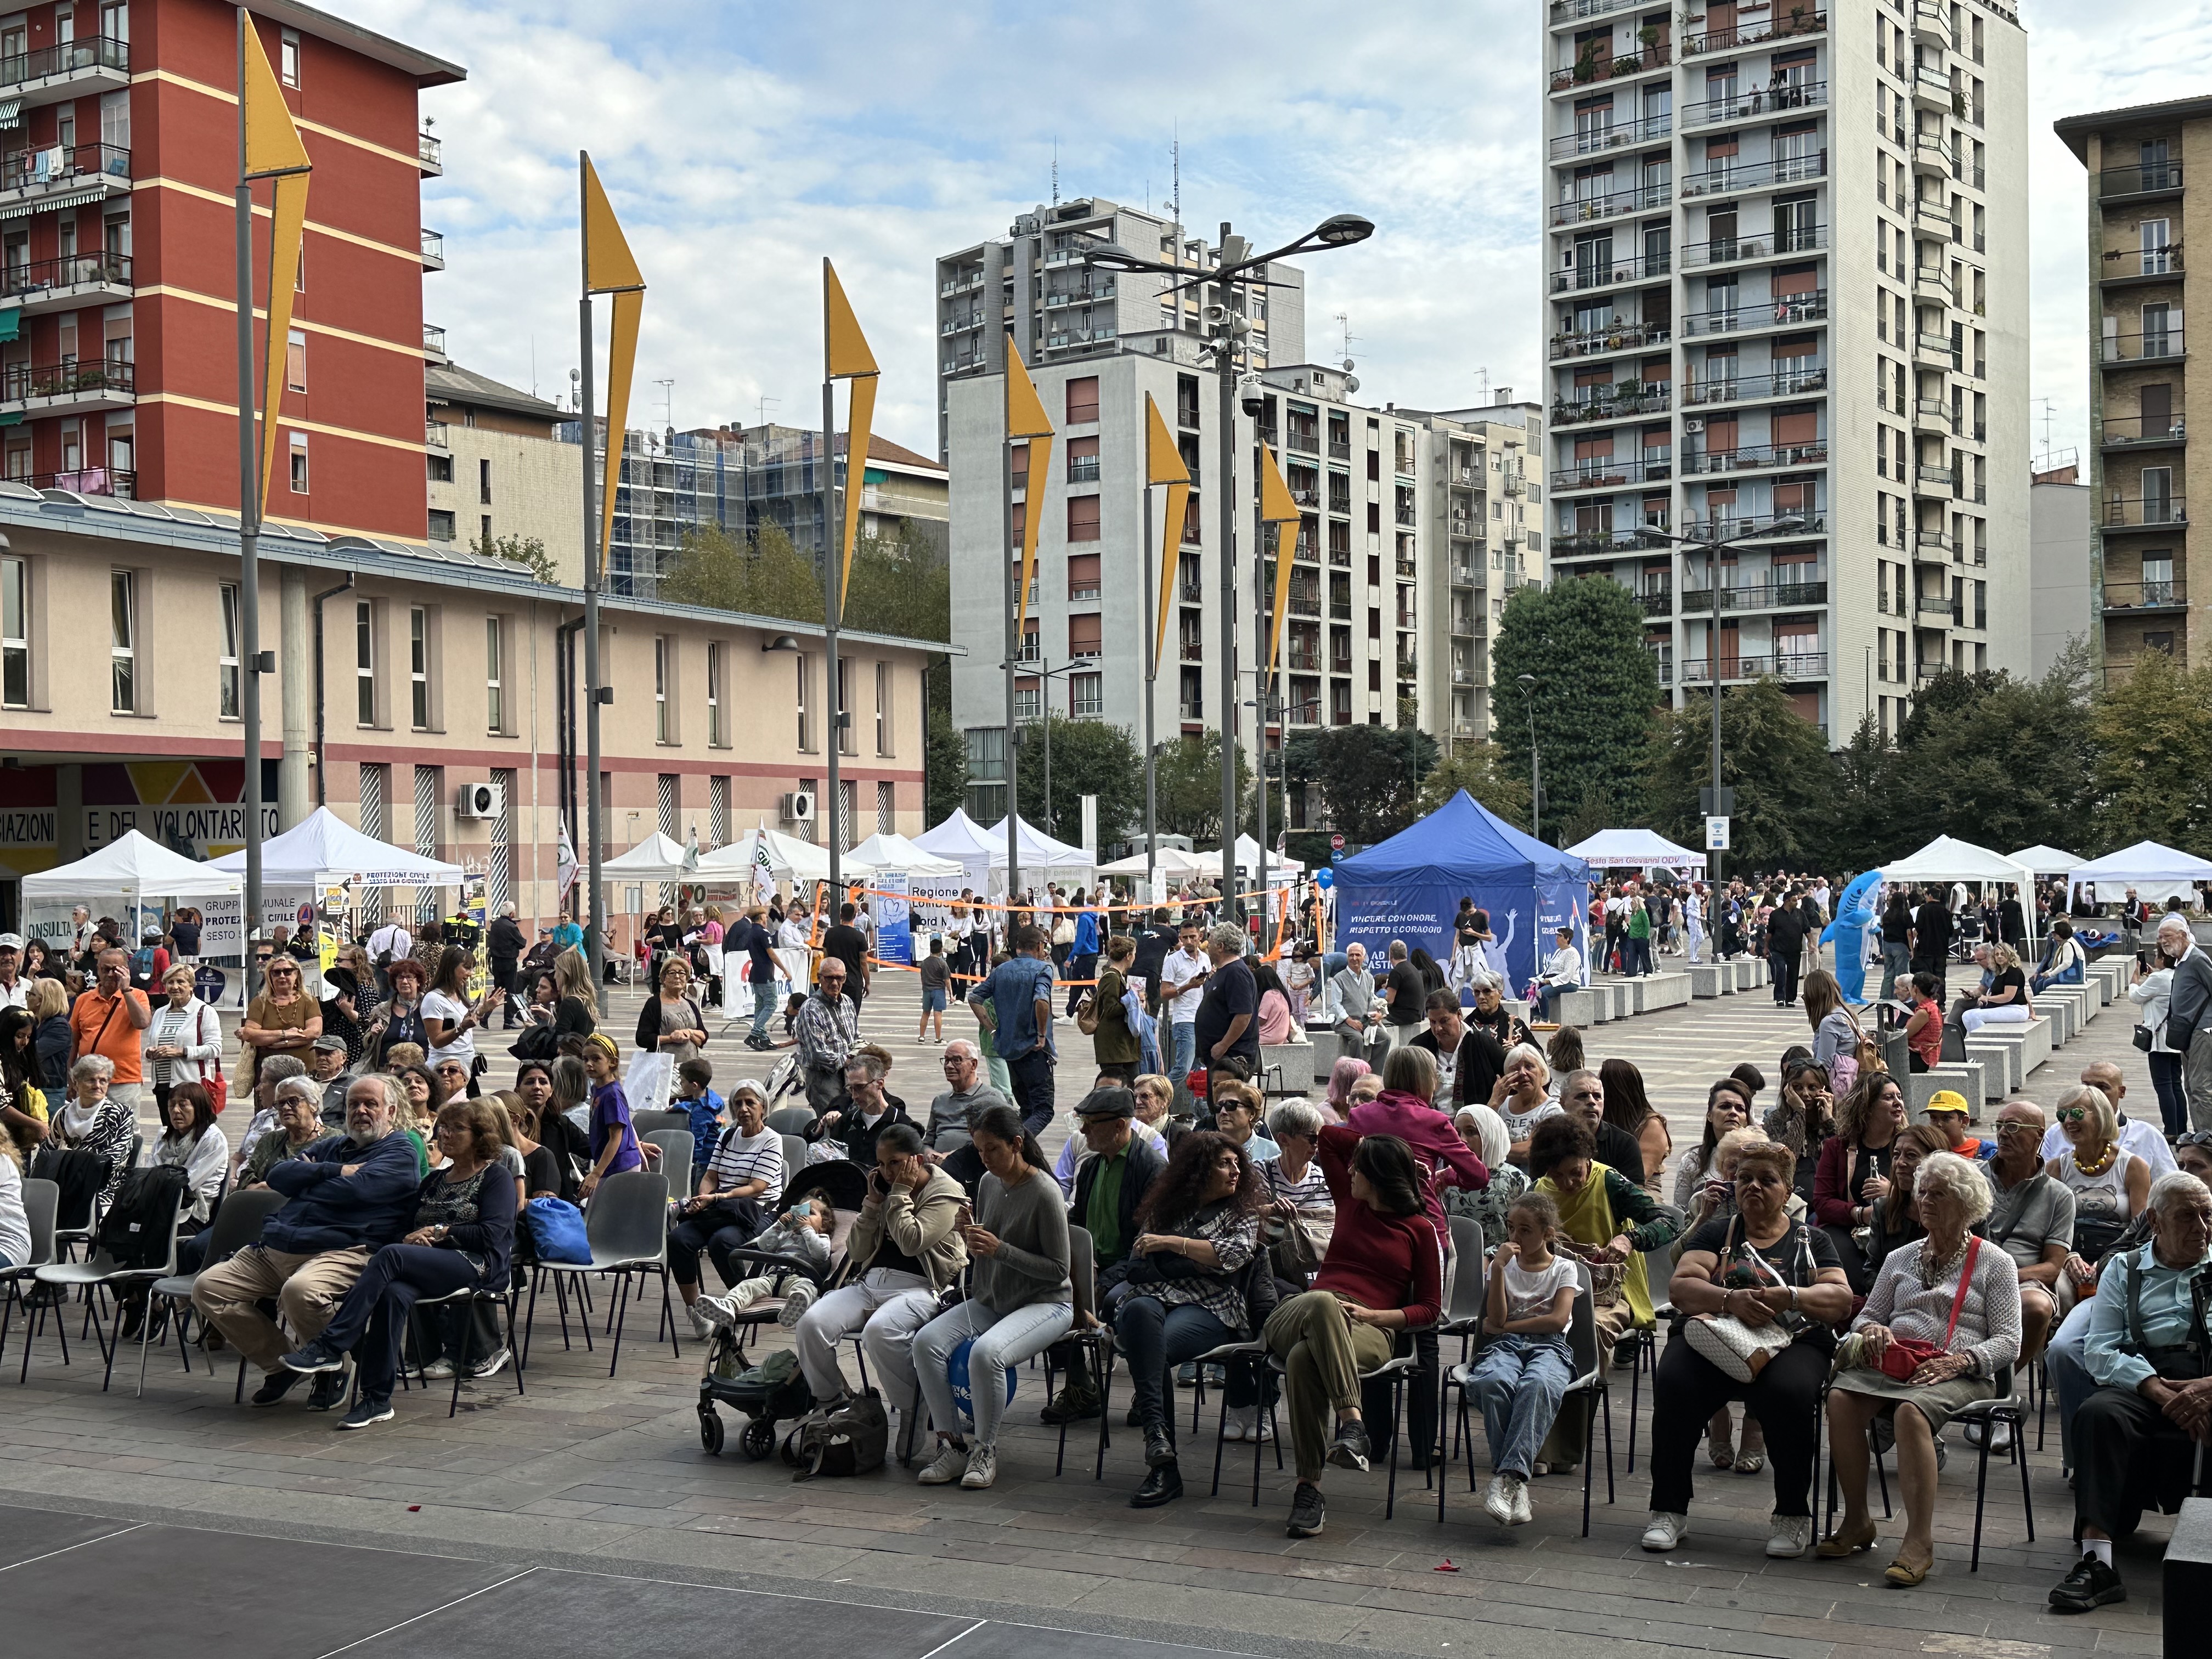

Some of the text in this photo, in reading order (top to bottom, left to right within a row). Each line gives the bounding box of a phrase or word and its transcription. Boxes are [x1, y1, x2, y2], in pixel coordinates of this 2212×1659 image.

[0, 813, 54, 842] IAZIONI
[89, 812, 99, 840] E
[153, 809, 278, 839] VOLONTARITO
[912, 886, 959, 899] Regione
[28, 921, 72, 939] ONSULTA
[206, 930, 235, 941] SESTO
